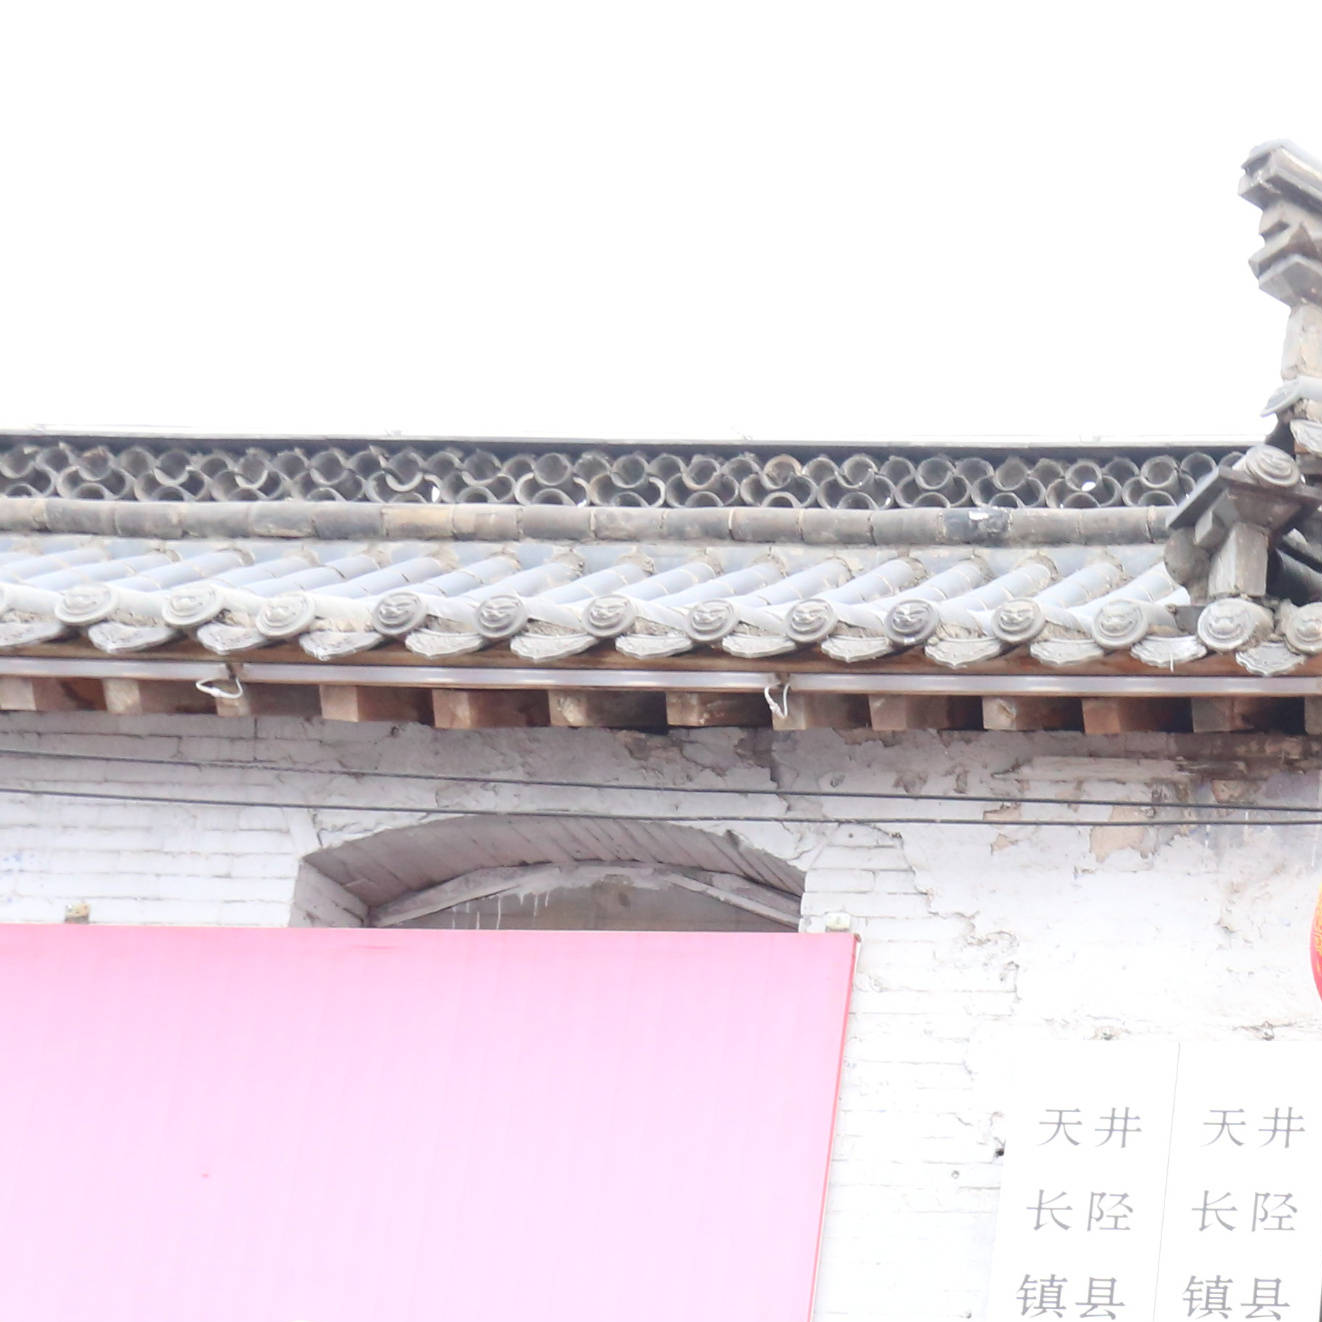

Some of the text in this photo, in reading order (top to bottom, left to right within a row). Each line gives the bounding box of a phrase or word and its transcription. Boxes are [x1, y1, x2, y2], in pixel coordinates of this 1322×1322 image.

[1016, 1107, 1082, 1321] 天长镇
[1074, 1107, 1143, 1321] 井陉县
[1181, 1107, 1246, 1322] 天长镇
[1239, 1107, 1307, 1322] 井陉县
